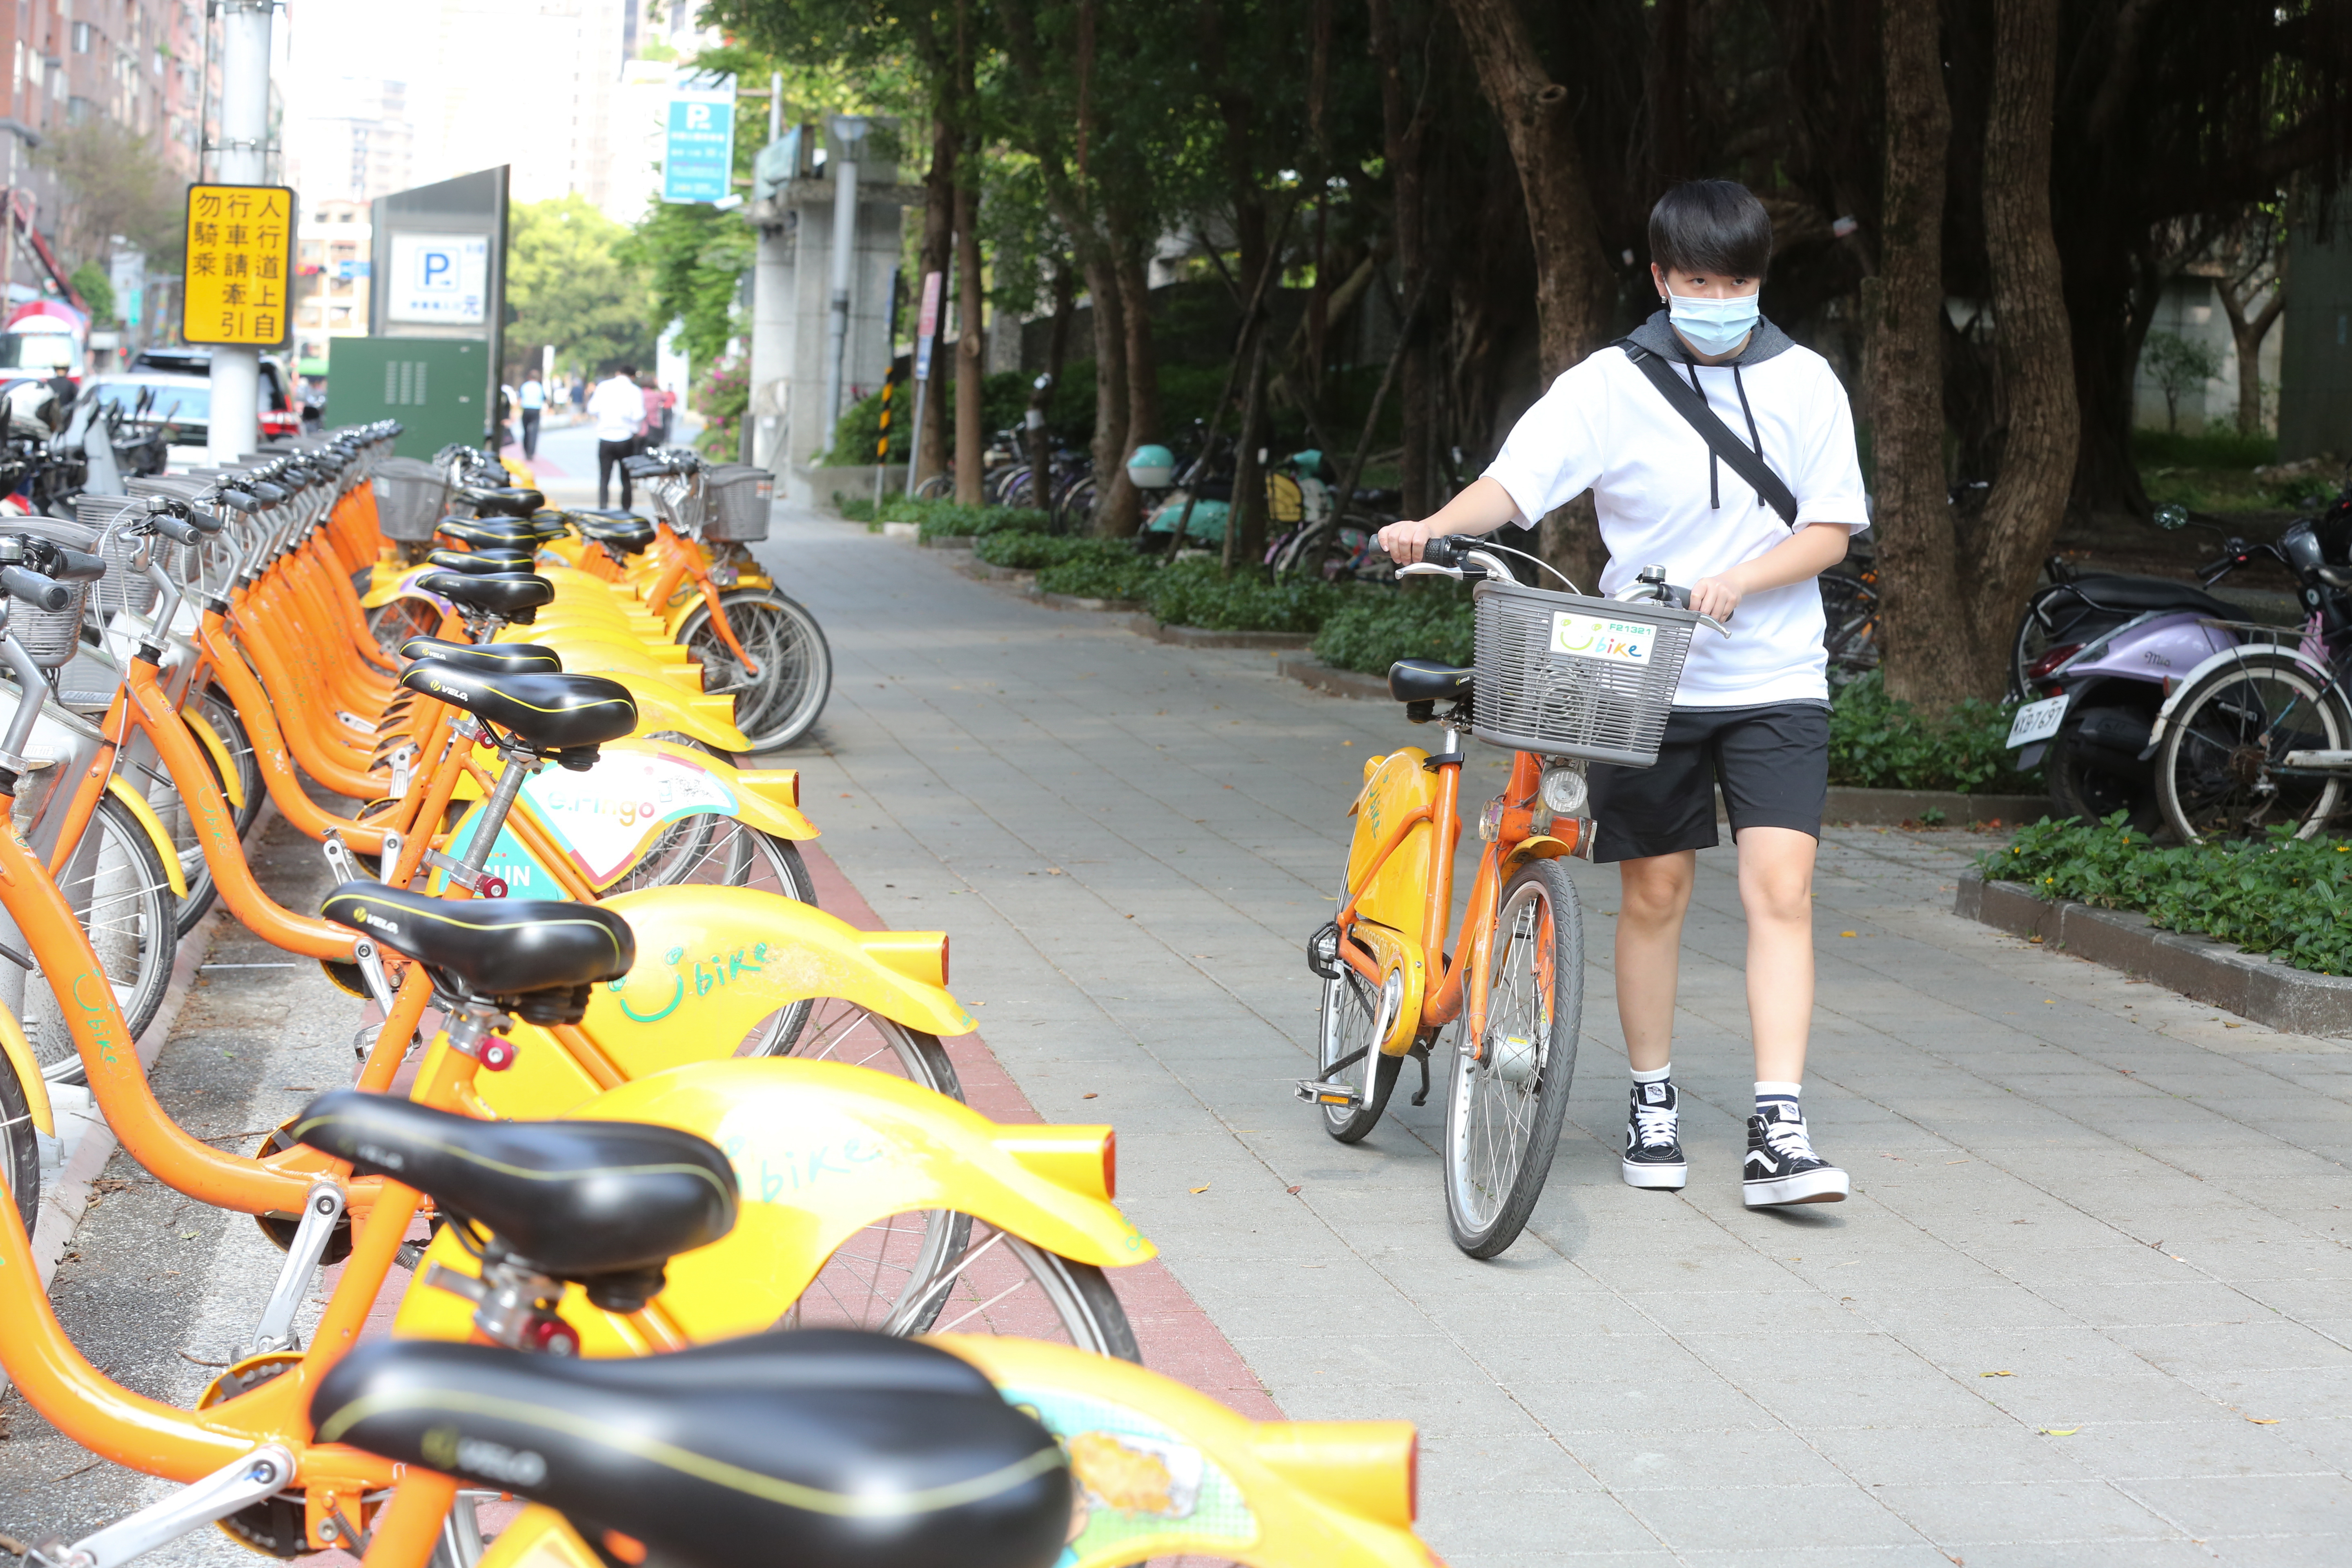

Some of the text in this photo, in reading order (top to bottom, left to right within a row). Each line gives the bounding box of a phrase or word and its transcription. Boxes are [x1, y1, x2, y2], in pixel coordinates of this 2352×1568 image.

[193, 192, 220, 277] 勿騎乘
[221, 194, 252, 337] 行車請牽引
[253, 195, 282, 338] 人行道上自
[425, 252, 449, 285] P
[1609, 623, 1651, 635] F21321
[429, 650, 445, 660] VELO
[441, 685, 468, 702] VELO
